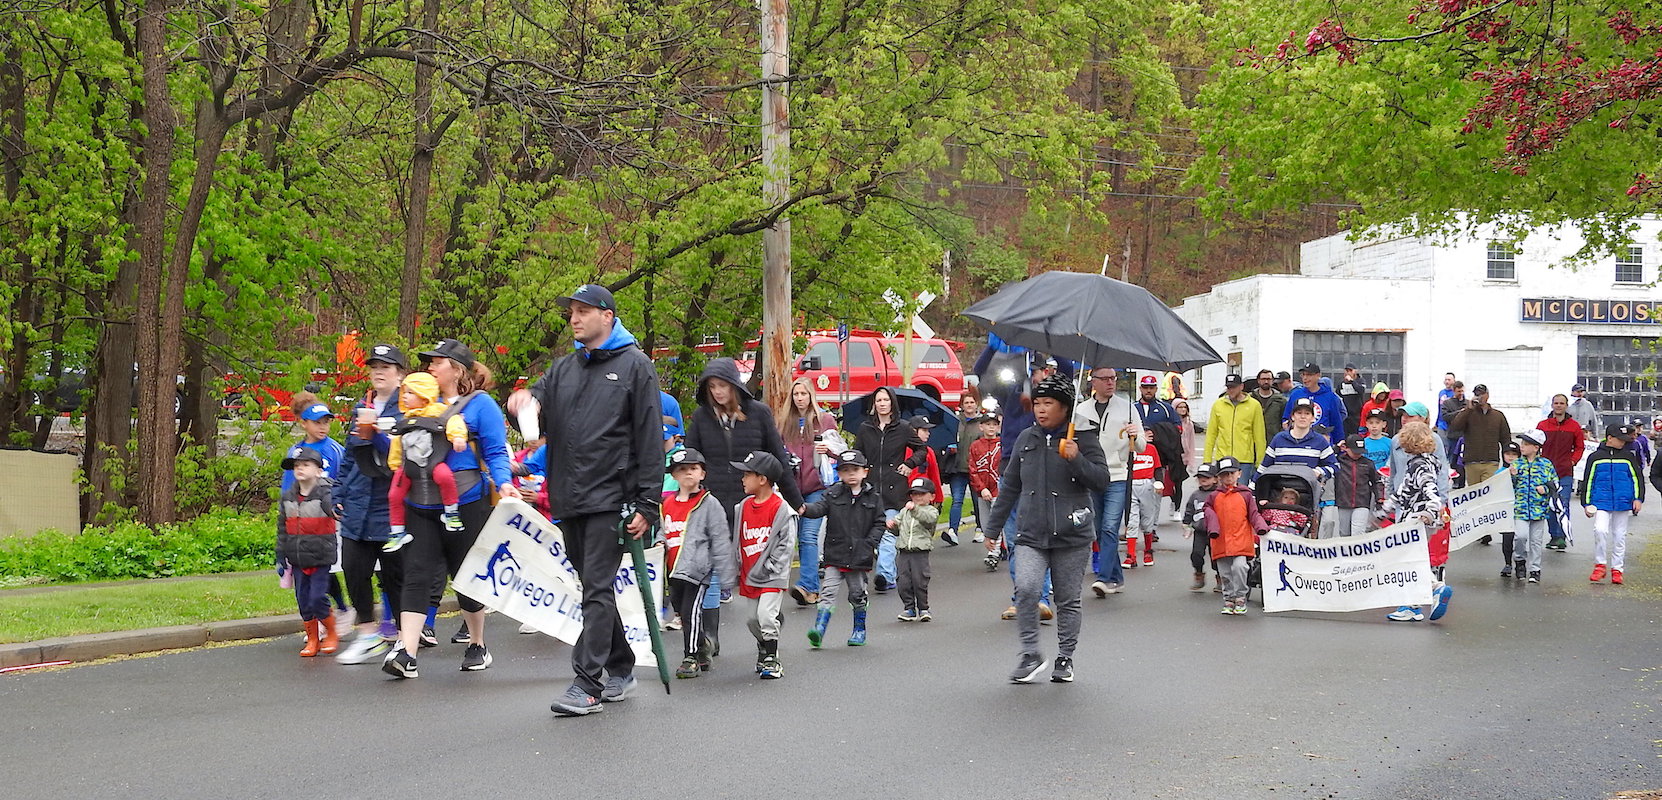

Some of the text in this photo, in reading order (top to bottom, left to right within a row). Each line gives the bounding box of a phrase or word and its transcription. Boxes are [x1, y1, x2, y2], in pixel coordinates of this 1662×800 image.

[1452, 485, 1490, 508] RADIO
[506, 513, 543, 544] ALL
[1450, 510, 1508, 538] Little League
[1267, 529, 1420, 560] APALACHIN LIONS CLUB
[1294, 569, 1418, 595] Owego Teener League
[1331, 563, 1375, 576] Supports
[499, 566, 555, 607] Owego
